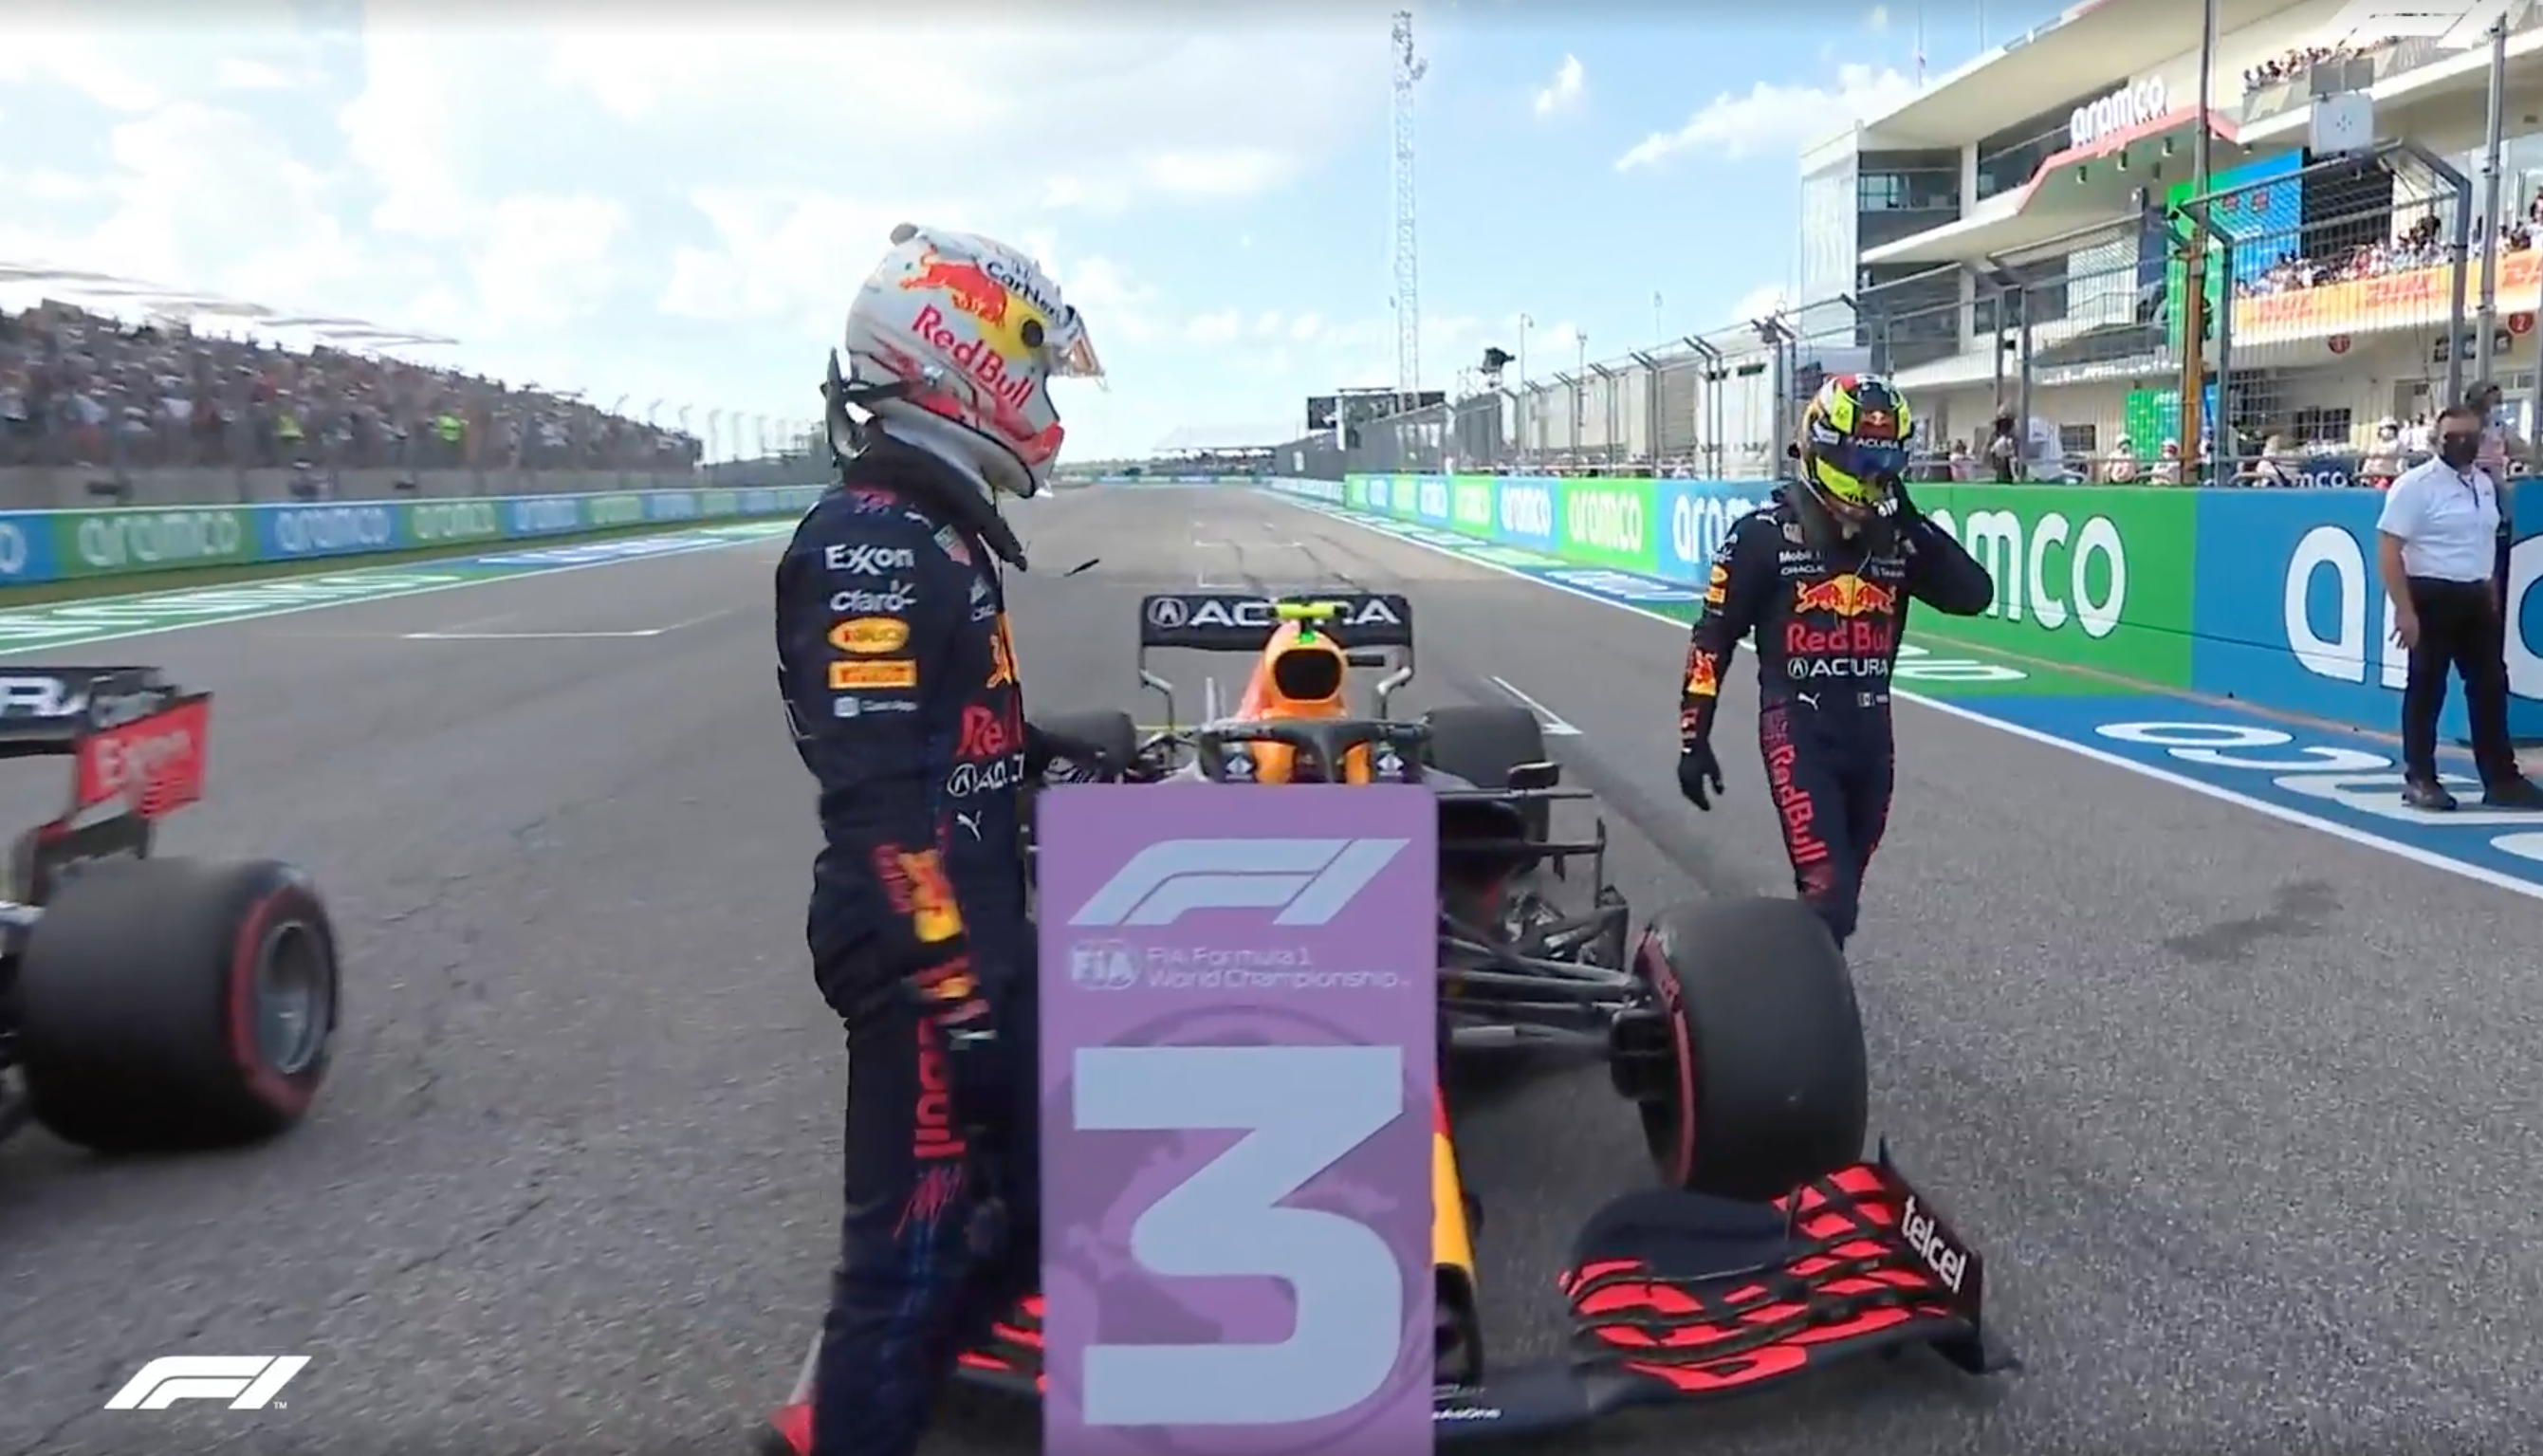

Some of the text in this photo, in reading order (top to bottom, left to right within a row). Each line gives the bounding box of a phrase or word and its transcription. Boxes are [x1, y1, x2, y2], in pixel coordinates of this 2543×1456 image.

[1568, 491, 1643, 553] aramco
[825, 544, 915, 575] Exxon
[1148, 969, 1399, 989] World Championship
[1192, 947, 1296, 966] Formula
[1074, 1045, 1405, 1425] 3
[1901, 1195, 1967, 1293] telcel
